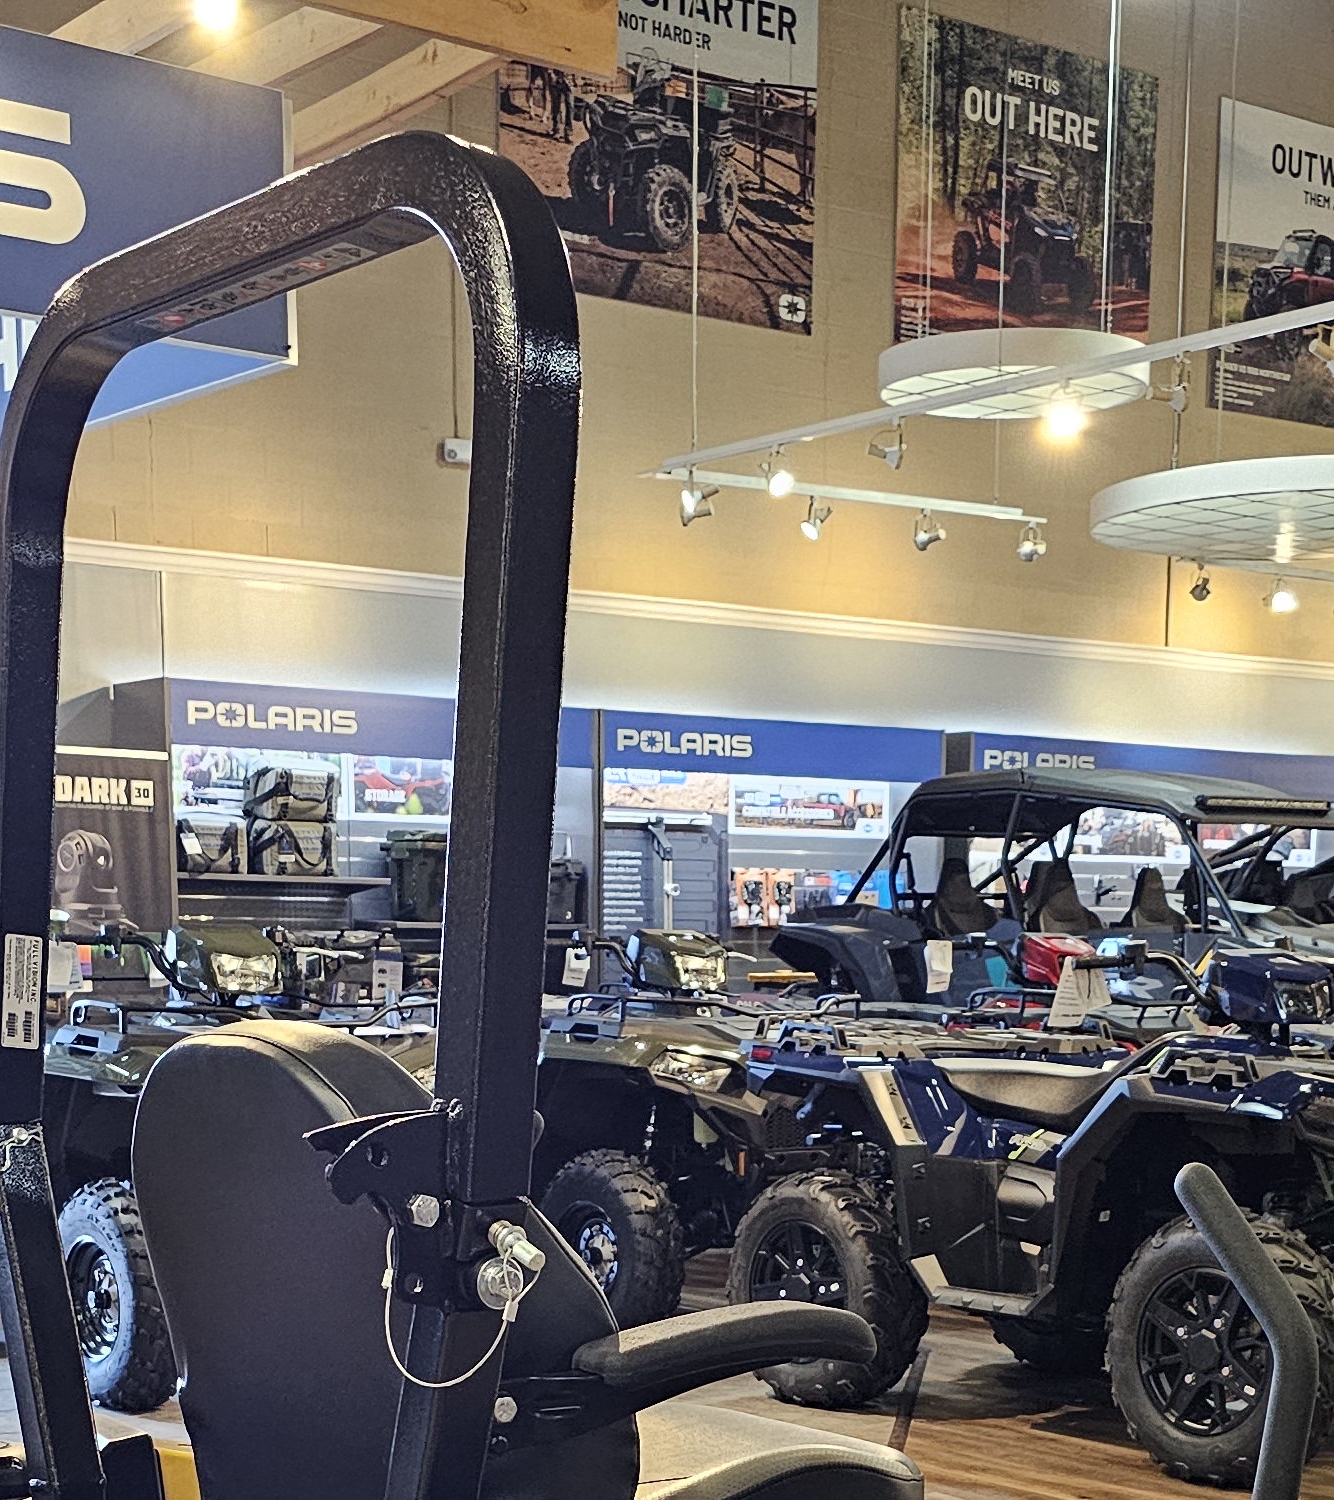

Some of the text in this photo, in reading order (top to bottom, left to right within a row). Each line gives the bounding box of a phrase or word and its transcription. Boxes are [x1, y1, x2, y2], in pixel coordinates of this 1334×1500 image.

[618, 10, 711, 50] NOT HARDER
[1008, 68, 1061, 95] MEET US
[965, 86, 1099, 152] OUT HERE
[1303, 190, 1330, 210] THEM
[186, 700, 358, 734] POLARIS
[616, 729, 753, 758] POLARIS
[54, 775, 150, 804] DARK 30
[32, 939, 40, 958] FULL
